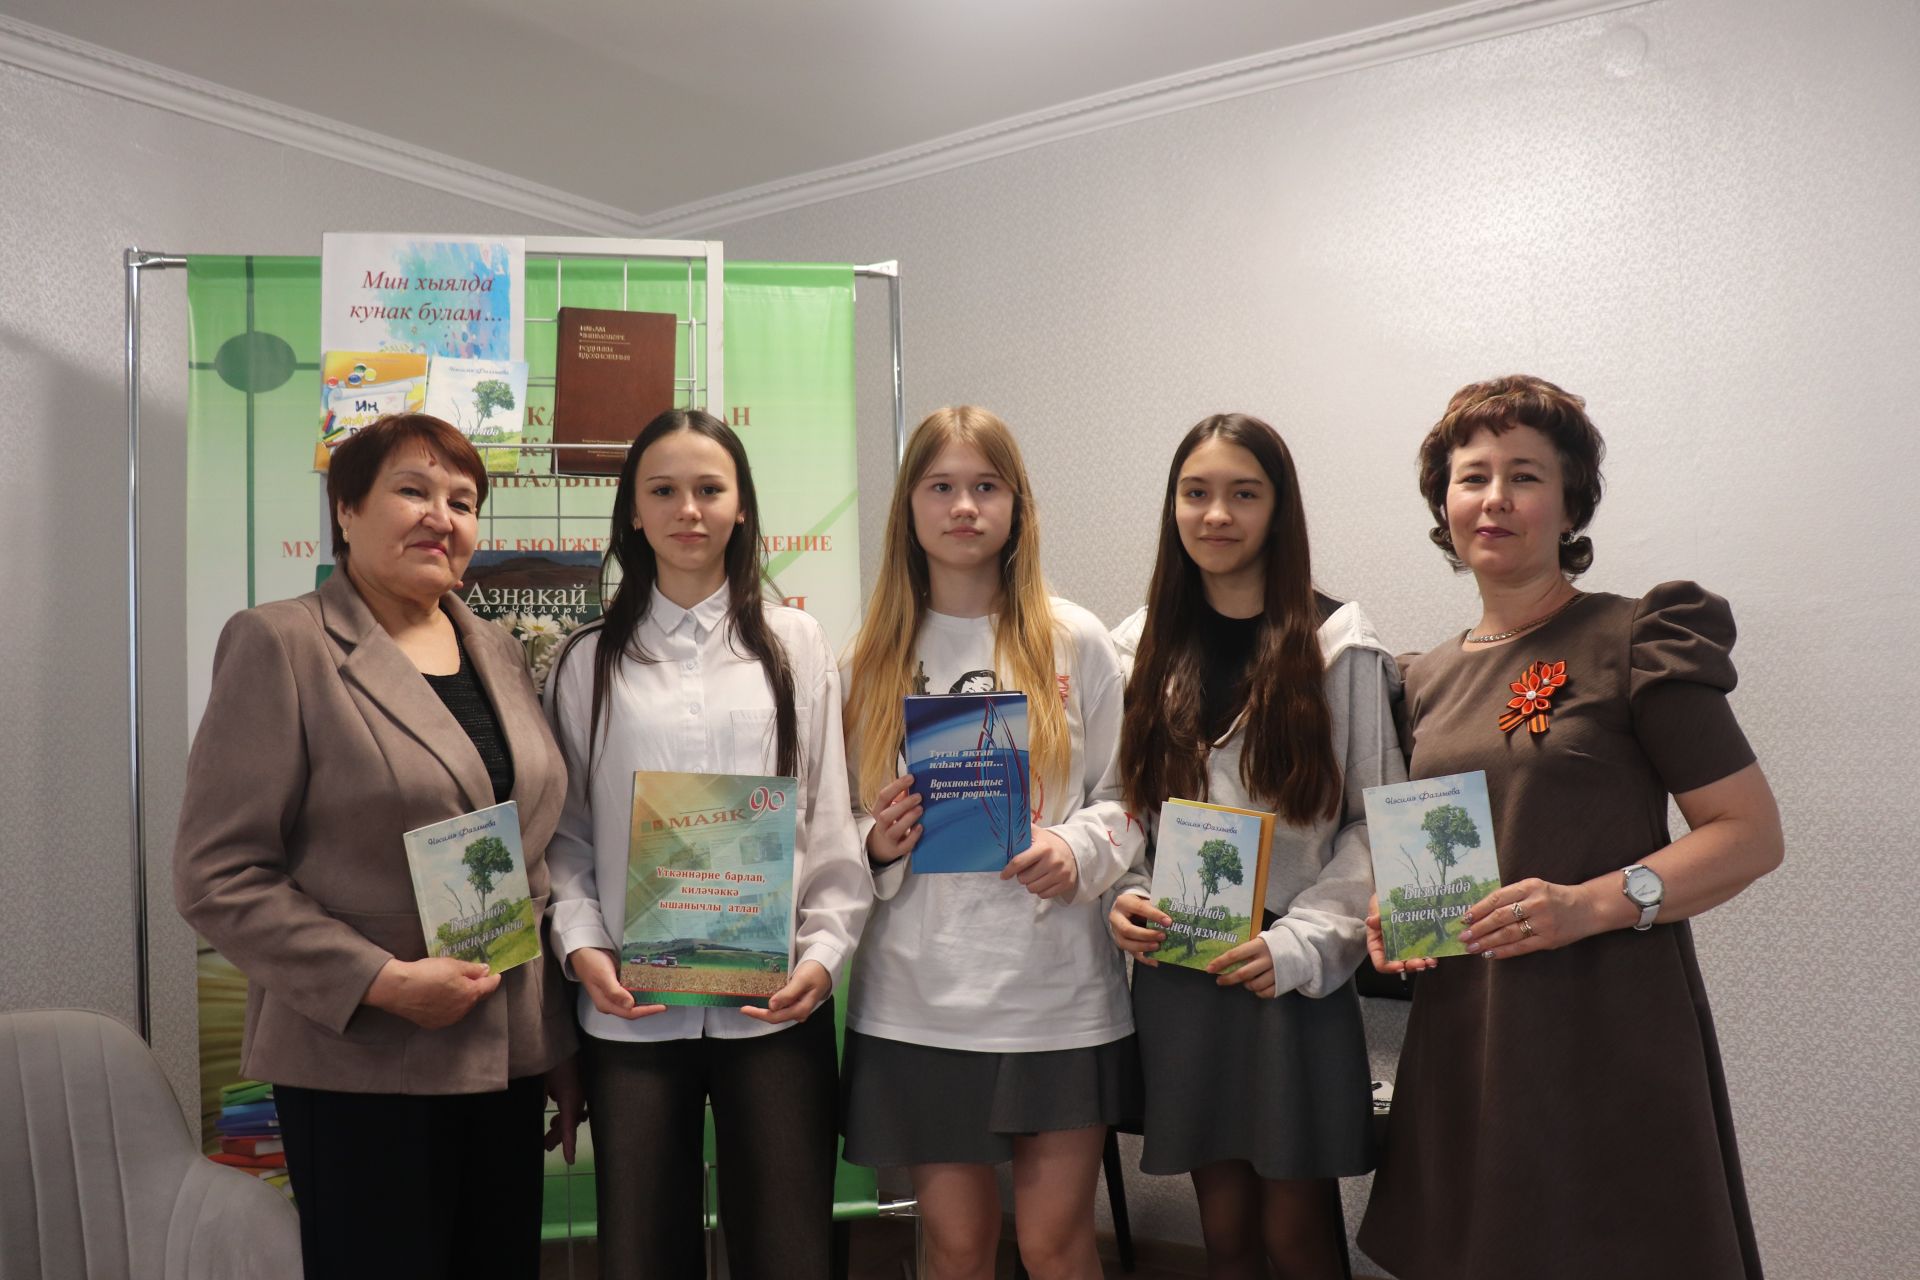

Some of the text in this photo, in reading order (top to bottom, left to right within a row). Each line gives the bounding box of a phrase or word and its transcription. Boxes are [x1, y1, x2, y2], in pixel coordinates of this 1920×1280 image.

[361, 270, 493, 292] Мин хыялда
[350, 304, 413, 323] кунак
[282, 540, 320, 558] МУ
[516, 537, 611, 552] БЮДЖЕ
[465, 582, 587, 606] Азнакай
[929, 749, 994, 760] Туган яктан
[929, 760, 962, 770] илһам
[930, 778, 1004, 789] Вдохновленные
[930, 790, 960, 801] краем
[668, 808, 748, 829] МАЯК
[656, 867, 766, 883] Үткәннәрне барлап,
[681, 886, 739, 897] киләчәккә
[1404, 880, 1472, 900] Бизмәндә
[659, 900, 759, 913] ышанычлы атлап
[1169, 899, 1226, 920] Бизмәндә
[1391, 904, 1472, 924] безнең язм
[450, 902, 507, 932] Бизмәндә
[439, 918, 525, 957] безнең язмыш
[1194, 927, 1239, 944] язмыш
